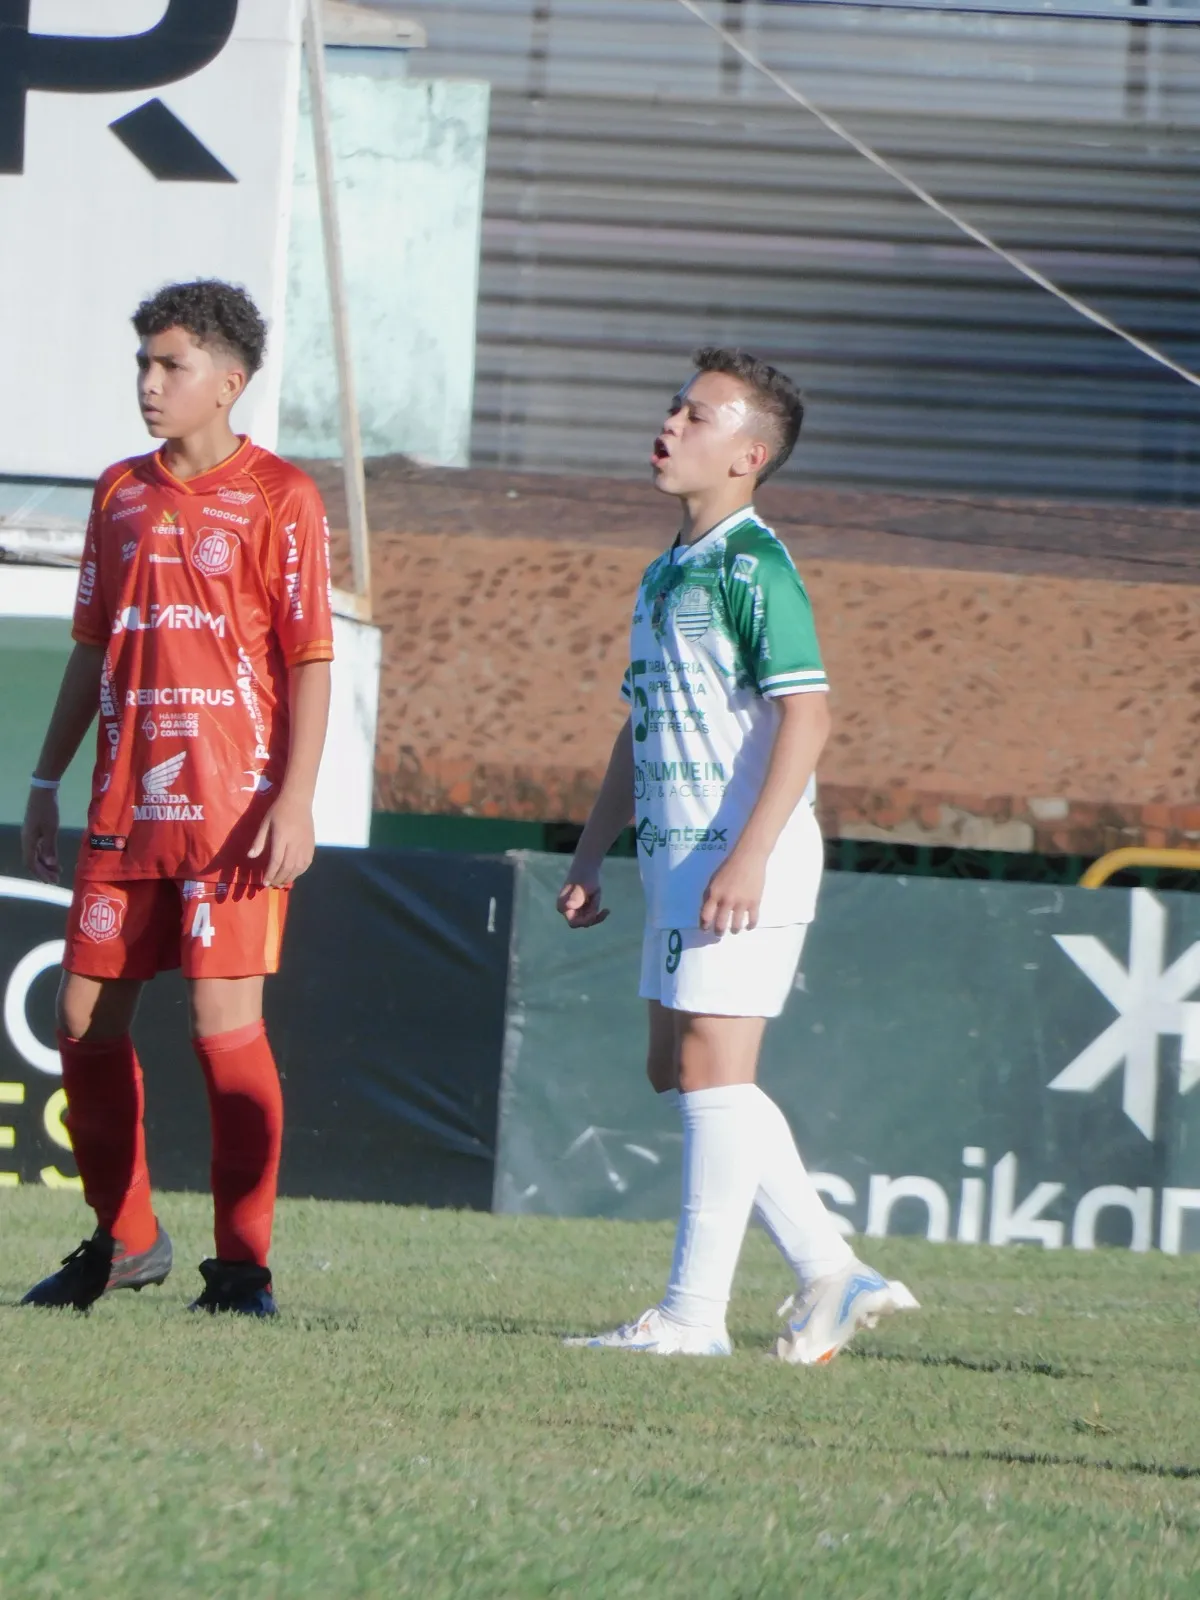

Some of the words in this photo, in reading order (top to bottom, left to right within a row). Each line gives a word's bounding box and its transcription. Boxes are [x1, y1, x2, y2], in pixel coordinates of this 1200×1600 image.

[202, 506, 250, 526] RODOCAP
[188, 712, 199, 721] DE
[160, 720, 172, 729] 40
[160, 729, 177, 737] COM
[142, 794, 189, 804] HONDA
[191, 902, 215, 948] 4
[665, 928, 682, 974] 9
